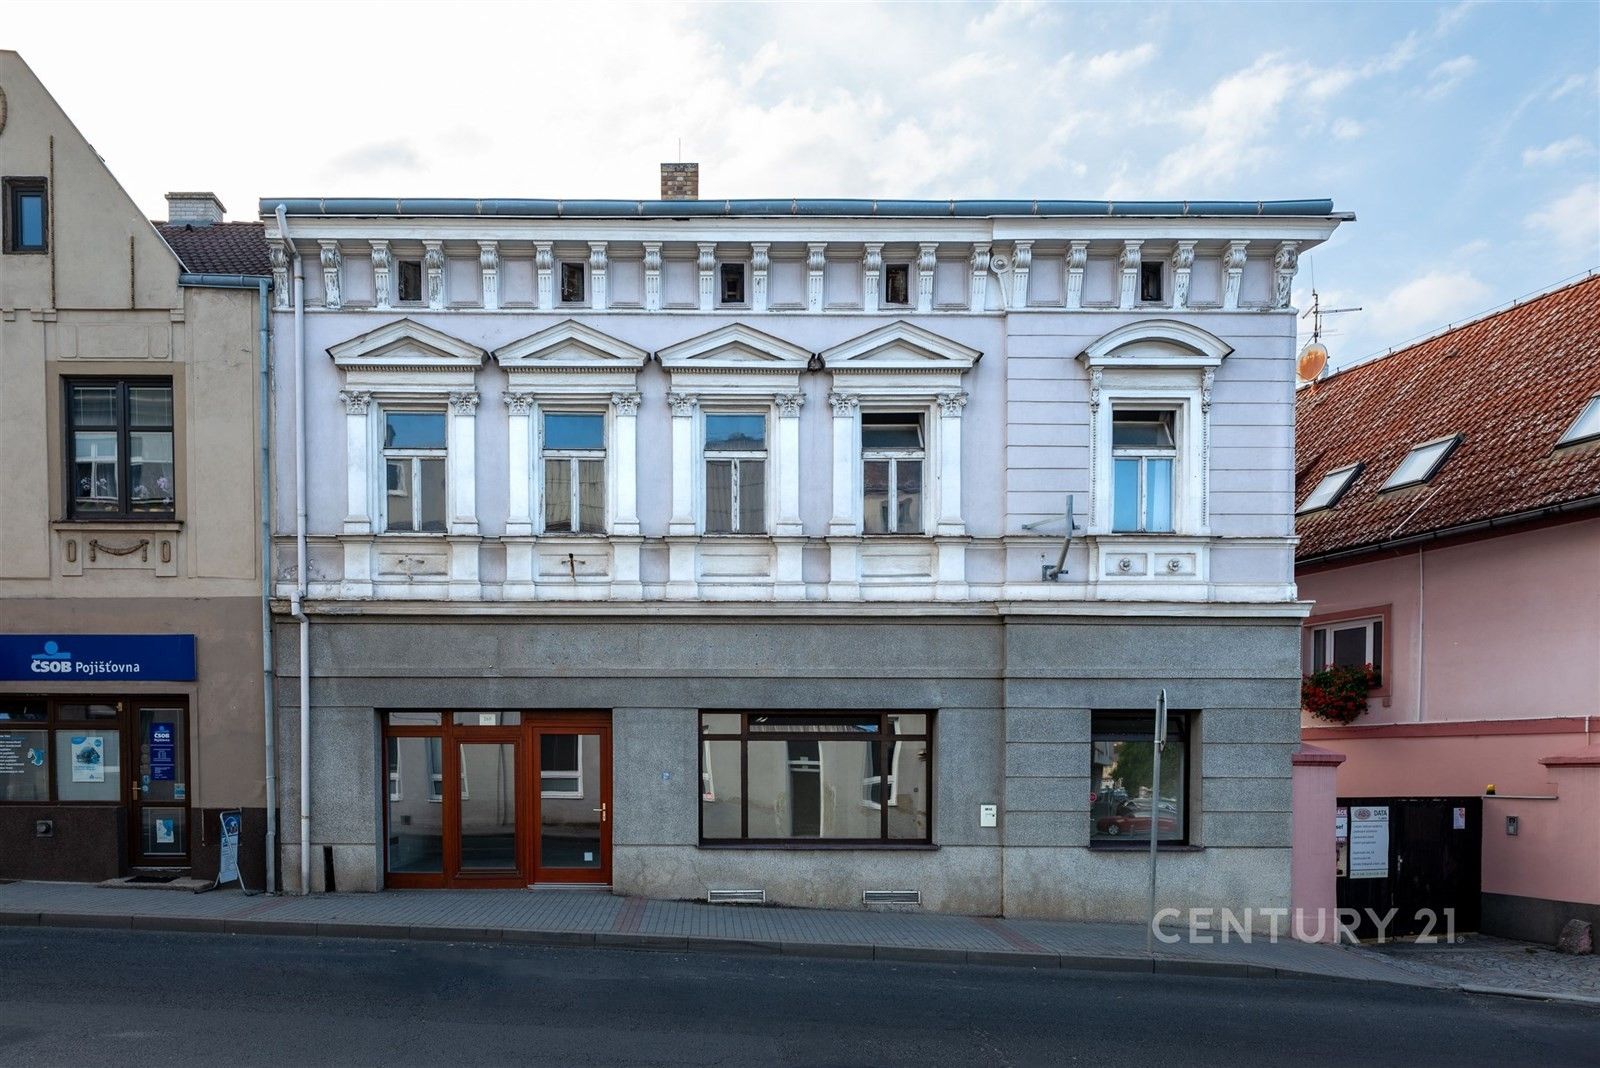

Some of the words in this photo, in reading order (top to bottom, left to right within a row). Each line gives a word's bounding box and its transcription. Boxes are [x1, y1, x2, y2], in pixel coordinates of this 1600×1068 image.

[31, 660, 72, 673] ČSOB
[75, 660, 140, 675] Pojišťovna
[1373, 809, 1387, 817] DATA
